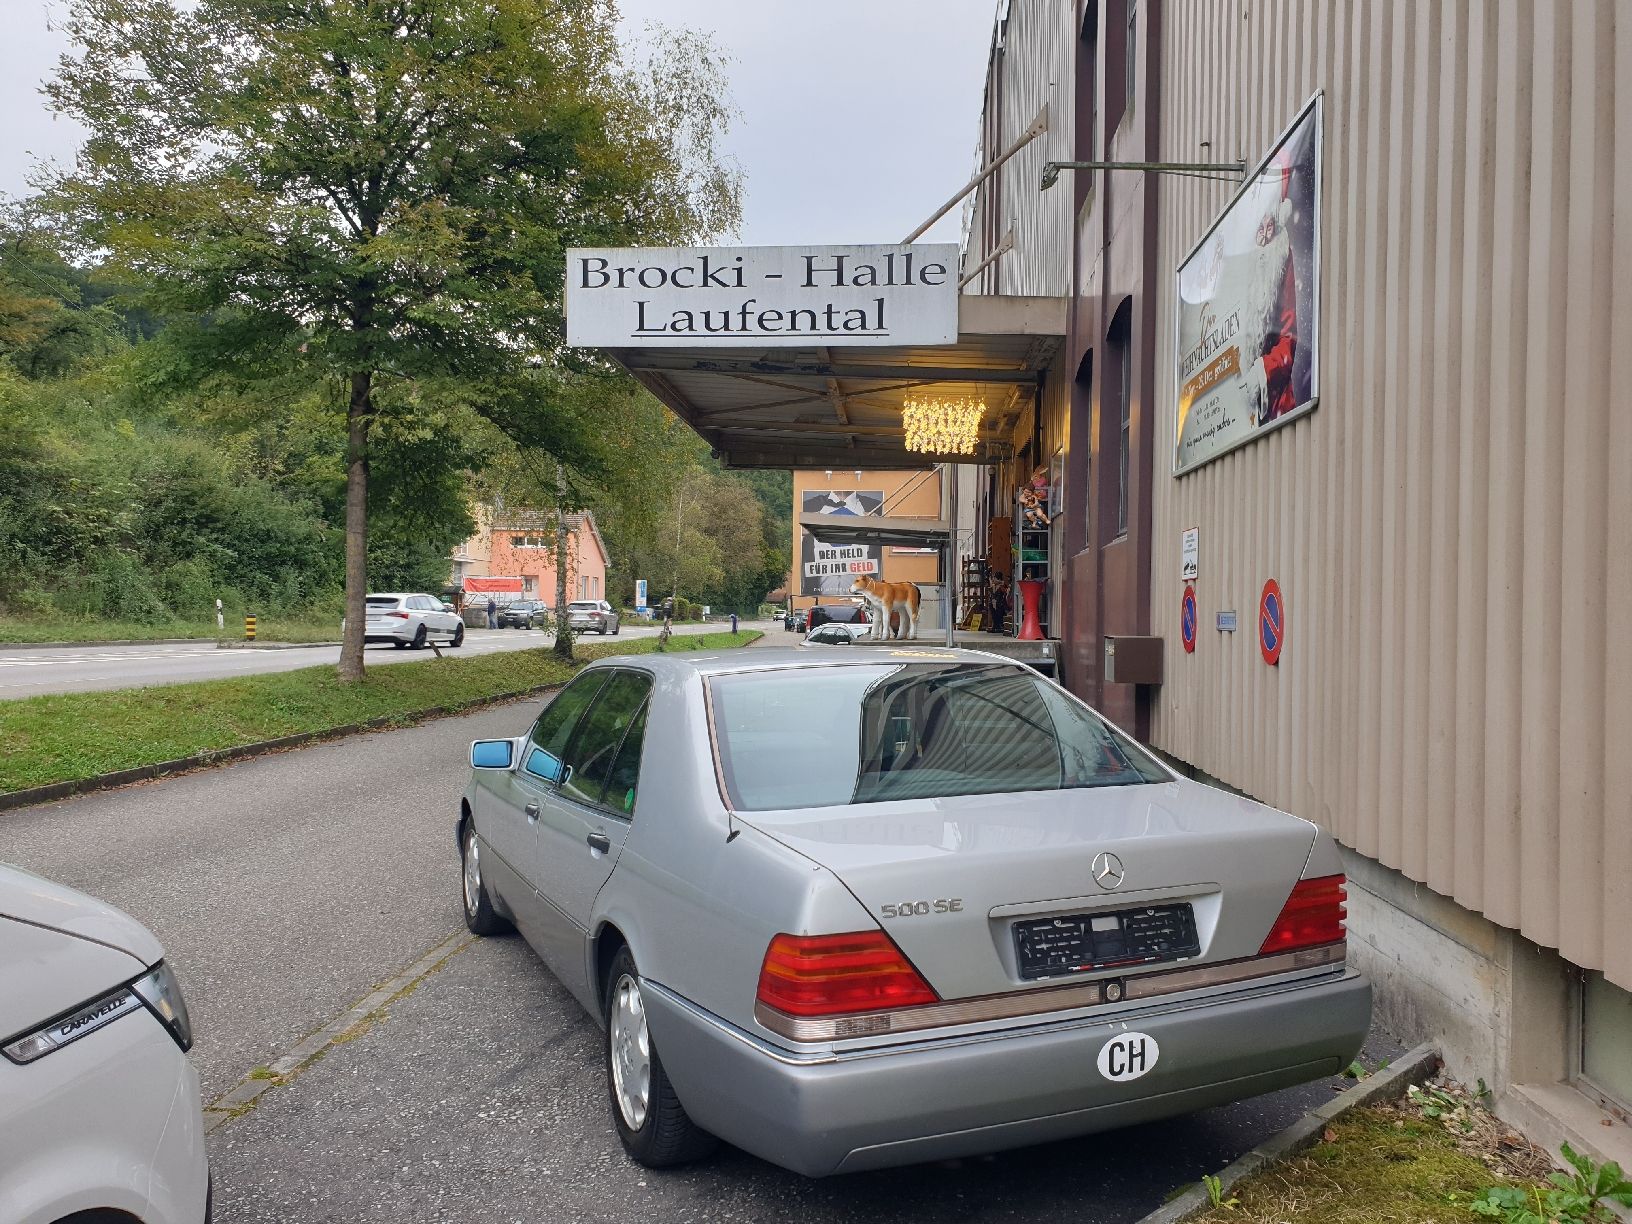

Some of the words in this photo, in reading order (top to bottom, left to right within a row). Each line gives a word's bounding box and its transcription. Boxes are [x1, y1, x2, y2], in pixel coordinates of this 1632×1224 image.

[579, 255, 748, 290] Brocki
[800, 253, 947, 288] Halle
[633, 297, 889, 333] Laufental
[809, 562, 828, 575] FÜR
[831, 563, 847, 574] IHR
[850, 561, 874, 573] GELD
[819, 549, 837, 560] DER
[840, 548, 863, 559] HELD
[881, 899, 930, 918] 500
[933, 898, 964, 915] SE
[60, 995, 127, 1036] CARAVELLE
[1107, 1036, 1147, 1077] CH
